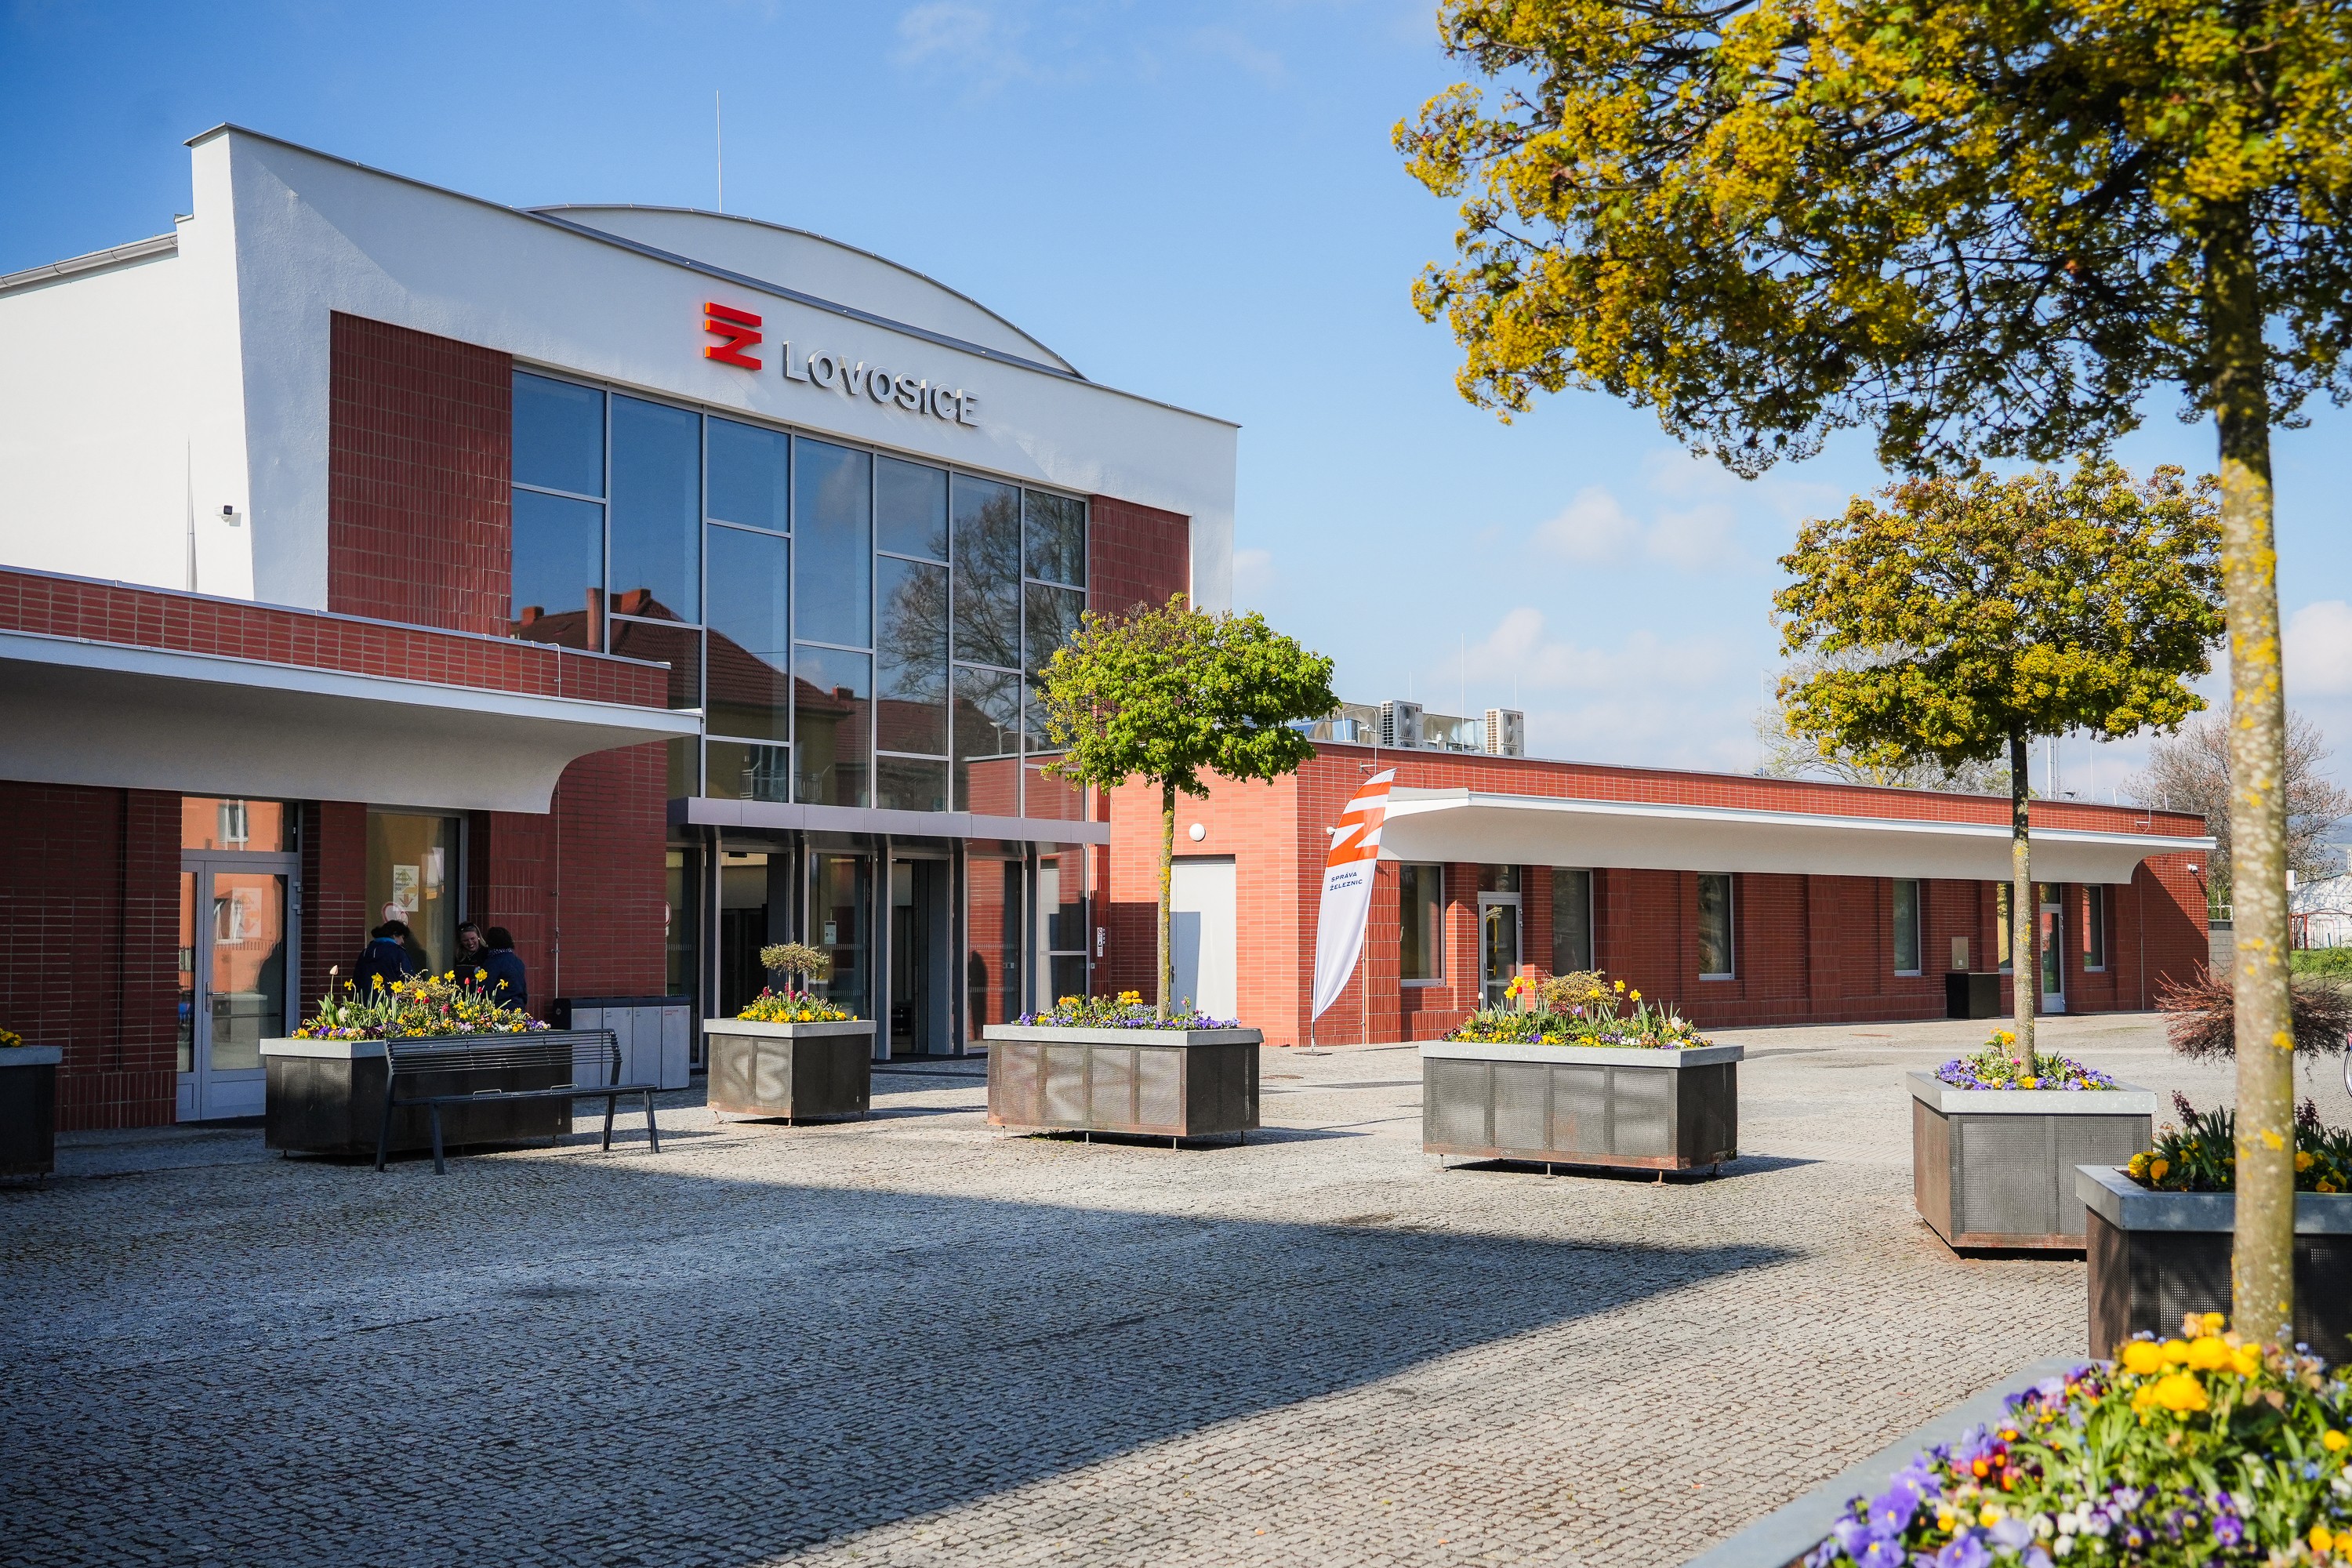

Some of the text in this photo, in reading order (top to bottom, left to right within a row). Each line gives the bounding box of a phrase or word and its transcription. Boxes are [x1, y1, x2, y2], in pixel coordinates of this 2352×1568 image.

[783, 340, 981, 426] LOVOSICE
[1331, 872, 1357, 882] SPRÁVA
[1330, 879, 1363, 891] ŽELEZNIC
